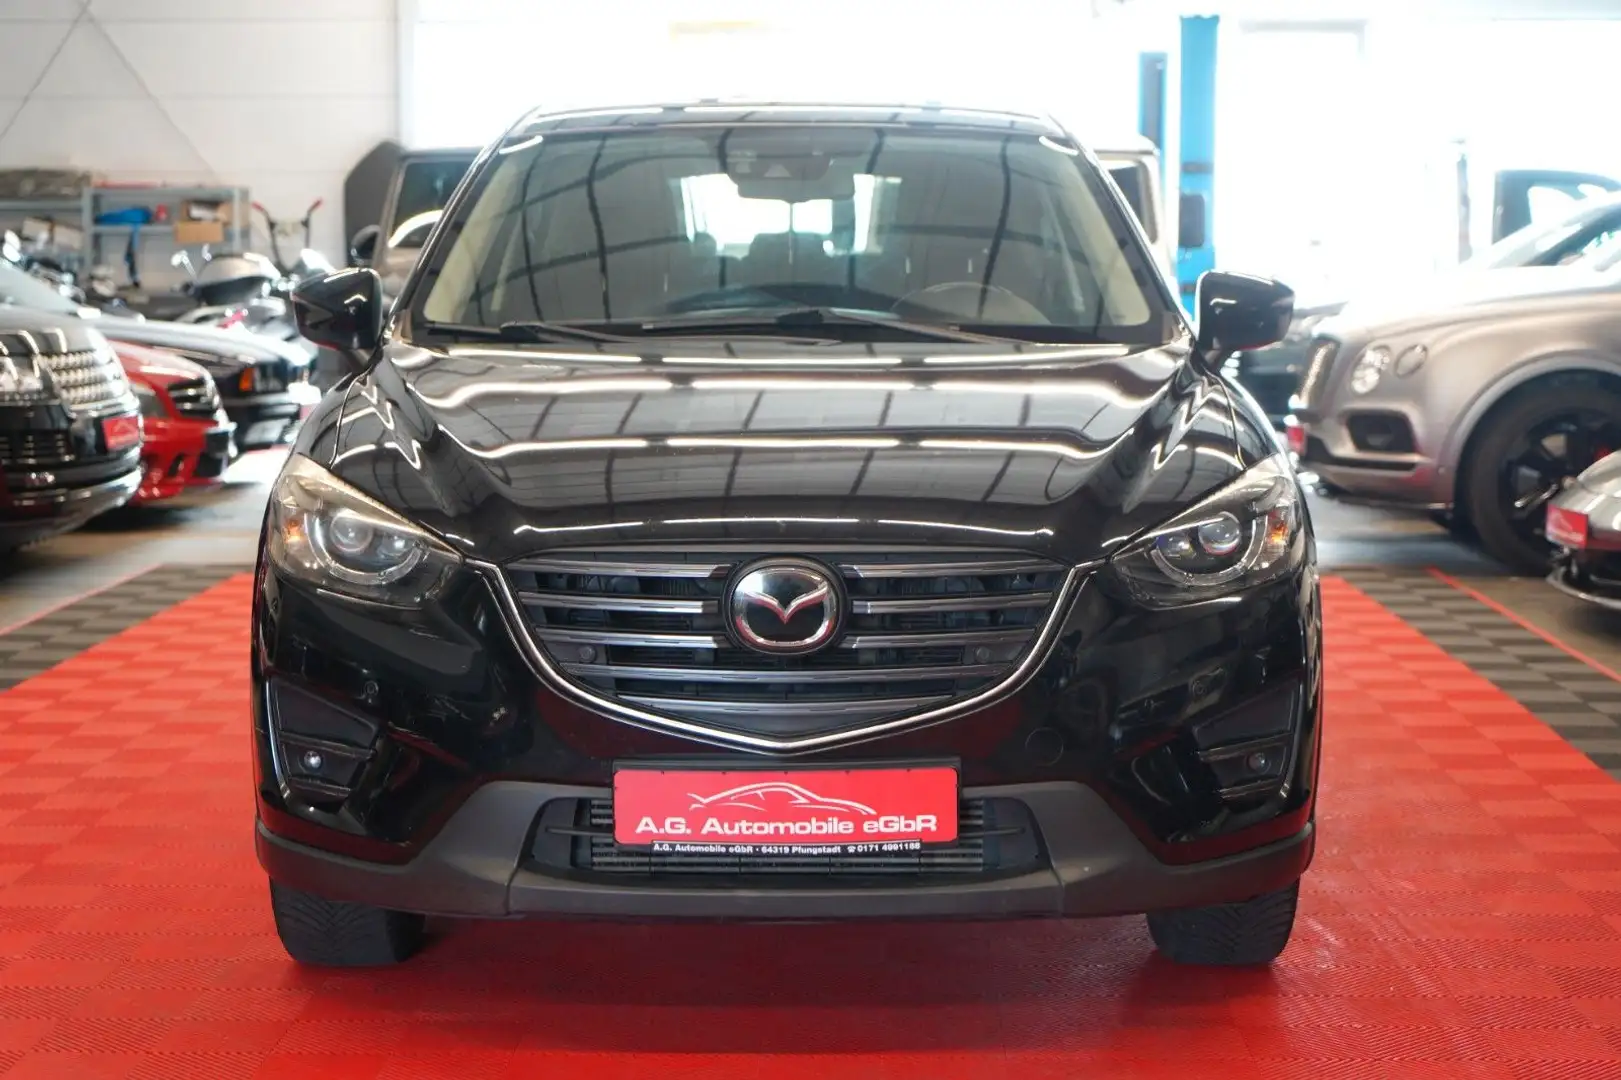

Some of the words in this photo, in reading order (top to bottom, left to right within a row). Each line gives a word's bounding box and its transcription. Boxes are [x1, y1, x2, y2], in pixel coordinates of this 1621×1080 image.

[635, 816, 692, 834] A.G.
[701, 816, 855, 835] Automobile
[863, 814, 937, 833] eGbR
[653, 843, 673, 852] A.G.
[675, 844, 727, 853] Automobile
[729, 845, 753, 853] eGbR
[792, 845, 841, 855] Pfungstadt
